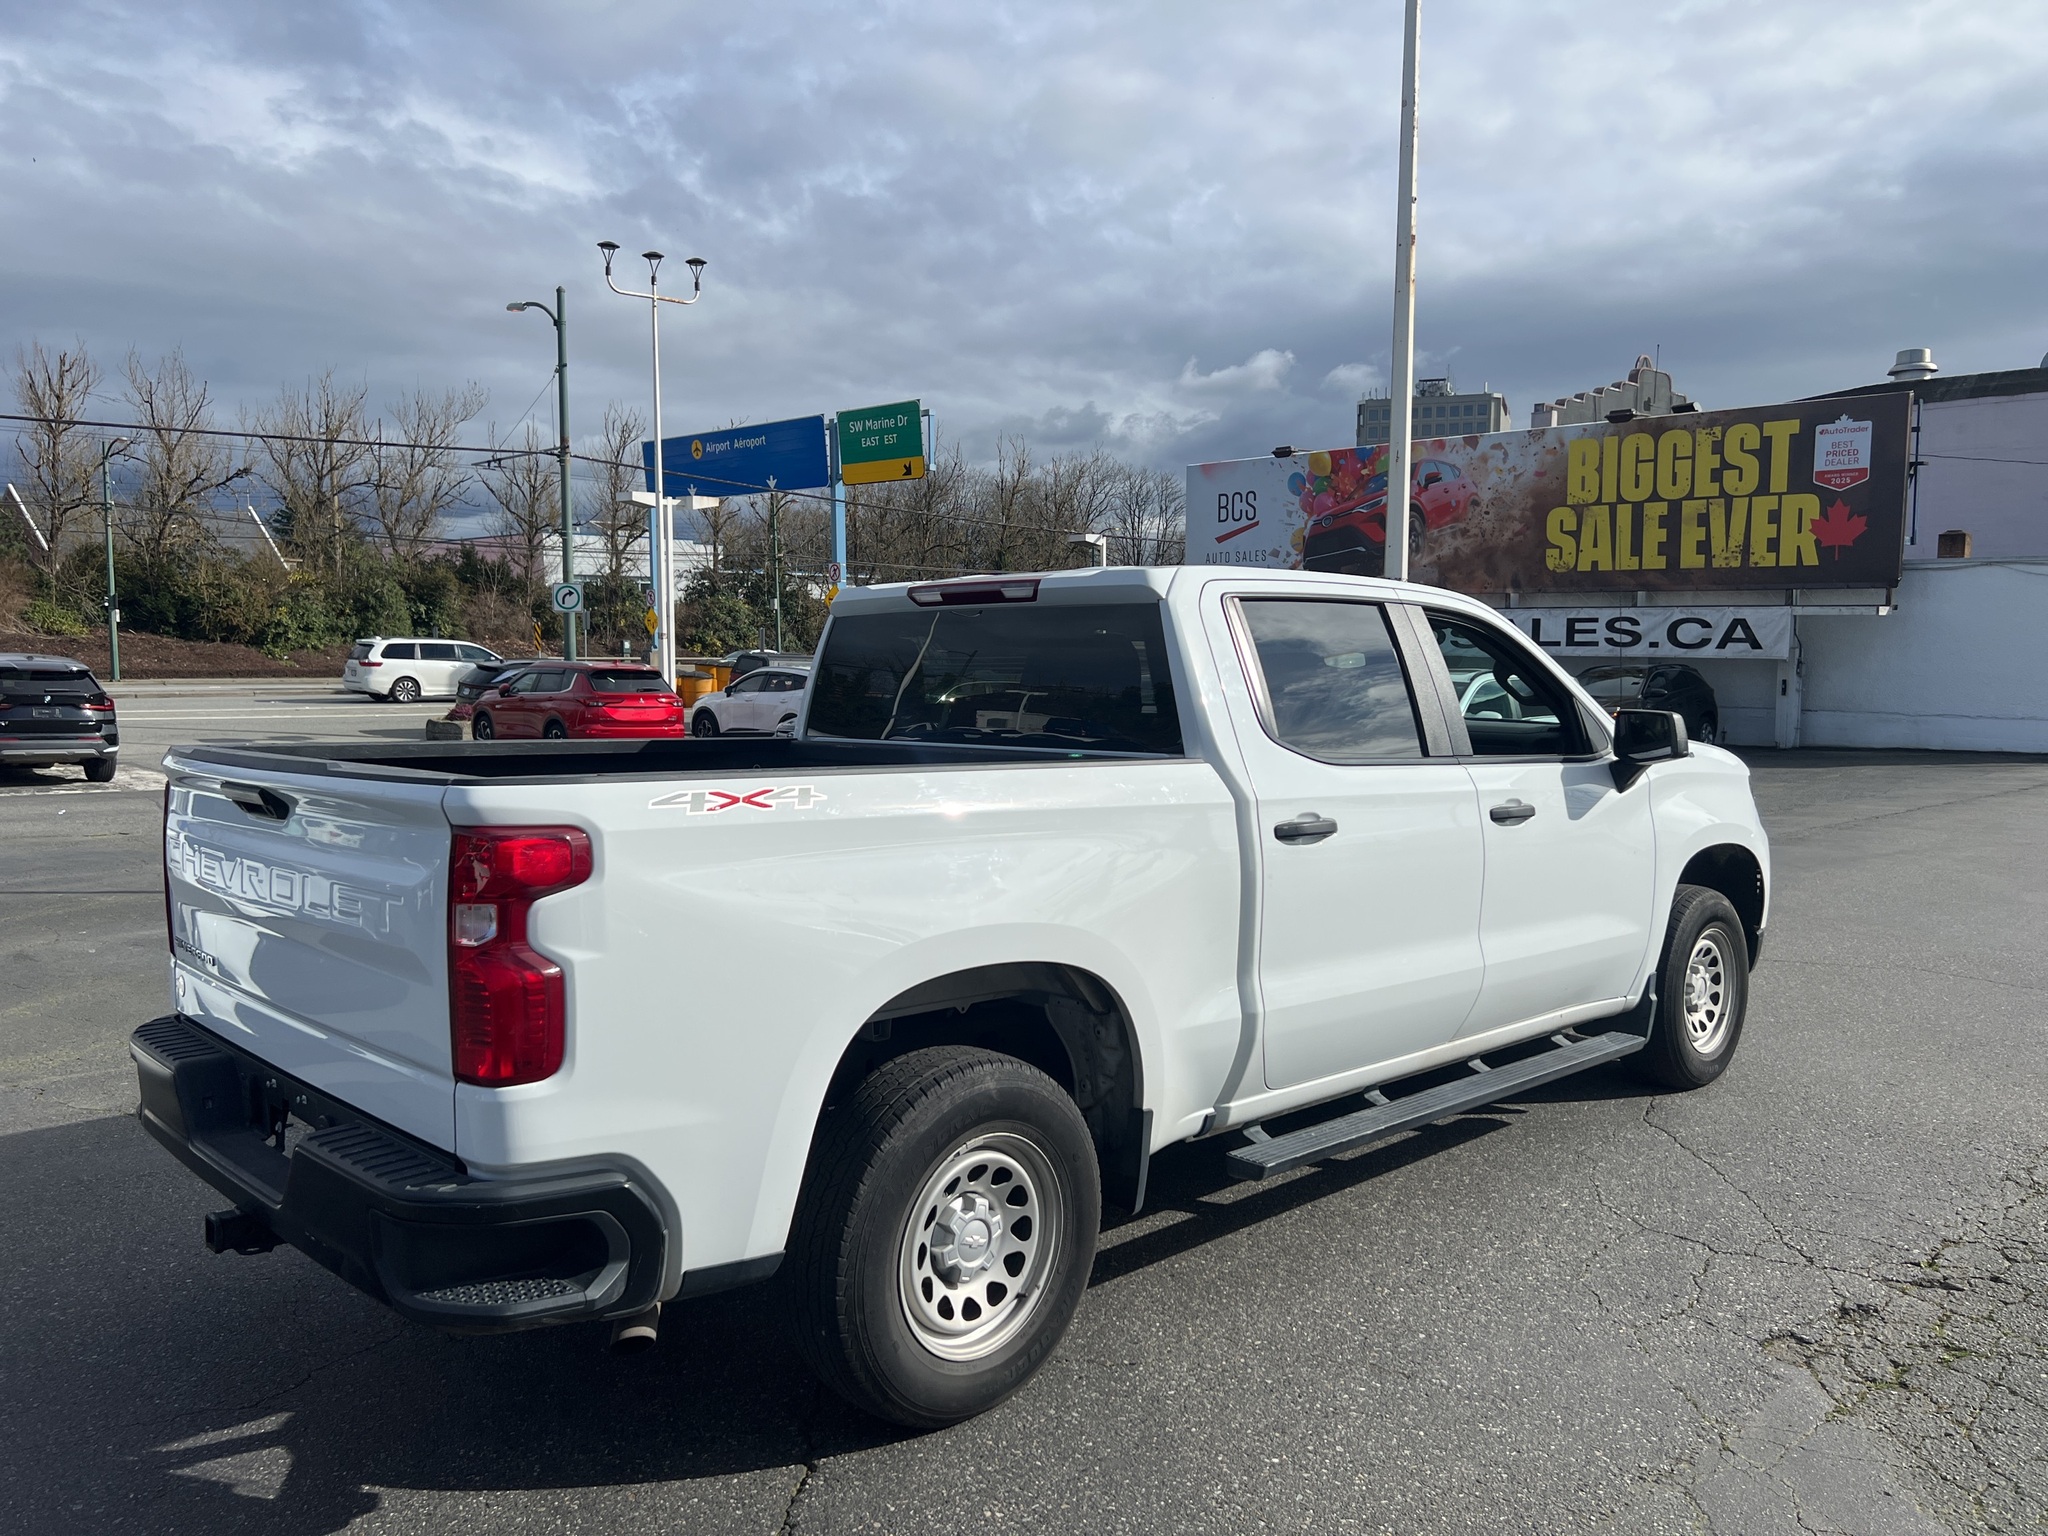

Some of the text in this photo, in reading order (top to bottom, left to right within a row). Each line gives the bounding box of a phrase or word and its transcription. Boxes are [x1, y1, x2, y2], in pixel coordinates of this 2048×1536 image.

[849, 414, 908, 433] SW Marine Dr
[1823, 426, 1869, 435] AutoTrader
[705, 434, 767, 454] Airport Aéroport
[861, 433, 898, 447] EAST EST
[1831, 440, 1854, 449] BEST
[1567, 419, 1801, 505] BIGGEST
[1824, 457, 1860, 467] DEALER
[1825, 448, 1859, 458] PRICED
[1217, 490, 1257, 523] BCS
[1545, 493, 1821, 573] SALE EVER
[1205, 549, 1267, 564] AUTO SALES
[1508, 615, 1763, 651] LES.CA
[168, 836, 404, 933] CHEVROLET
